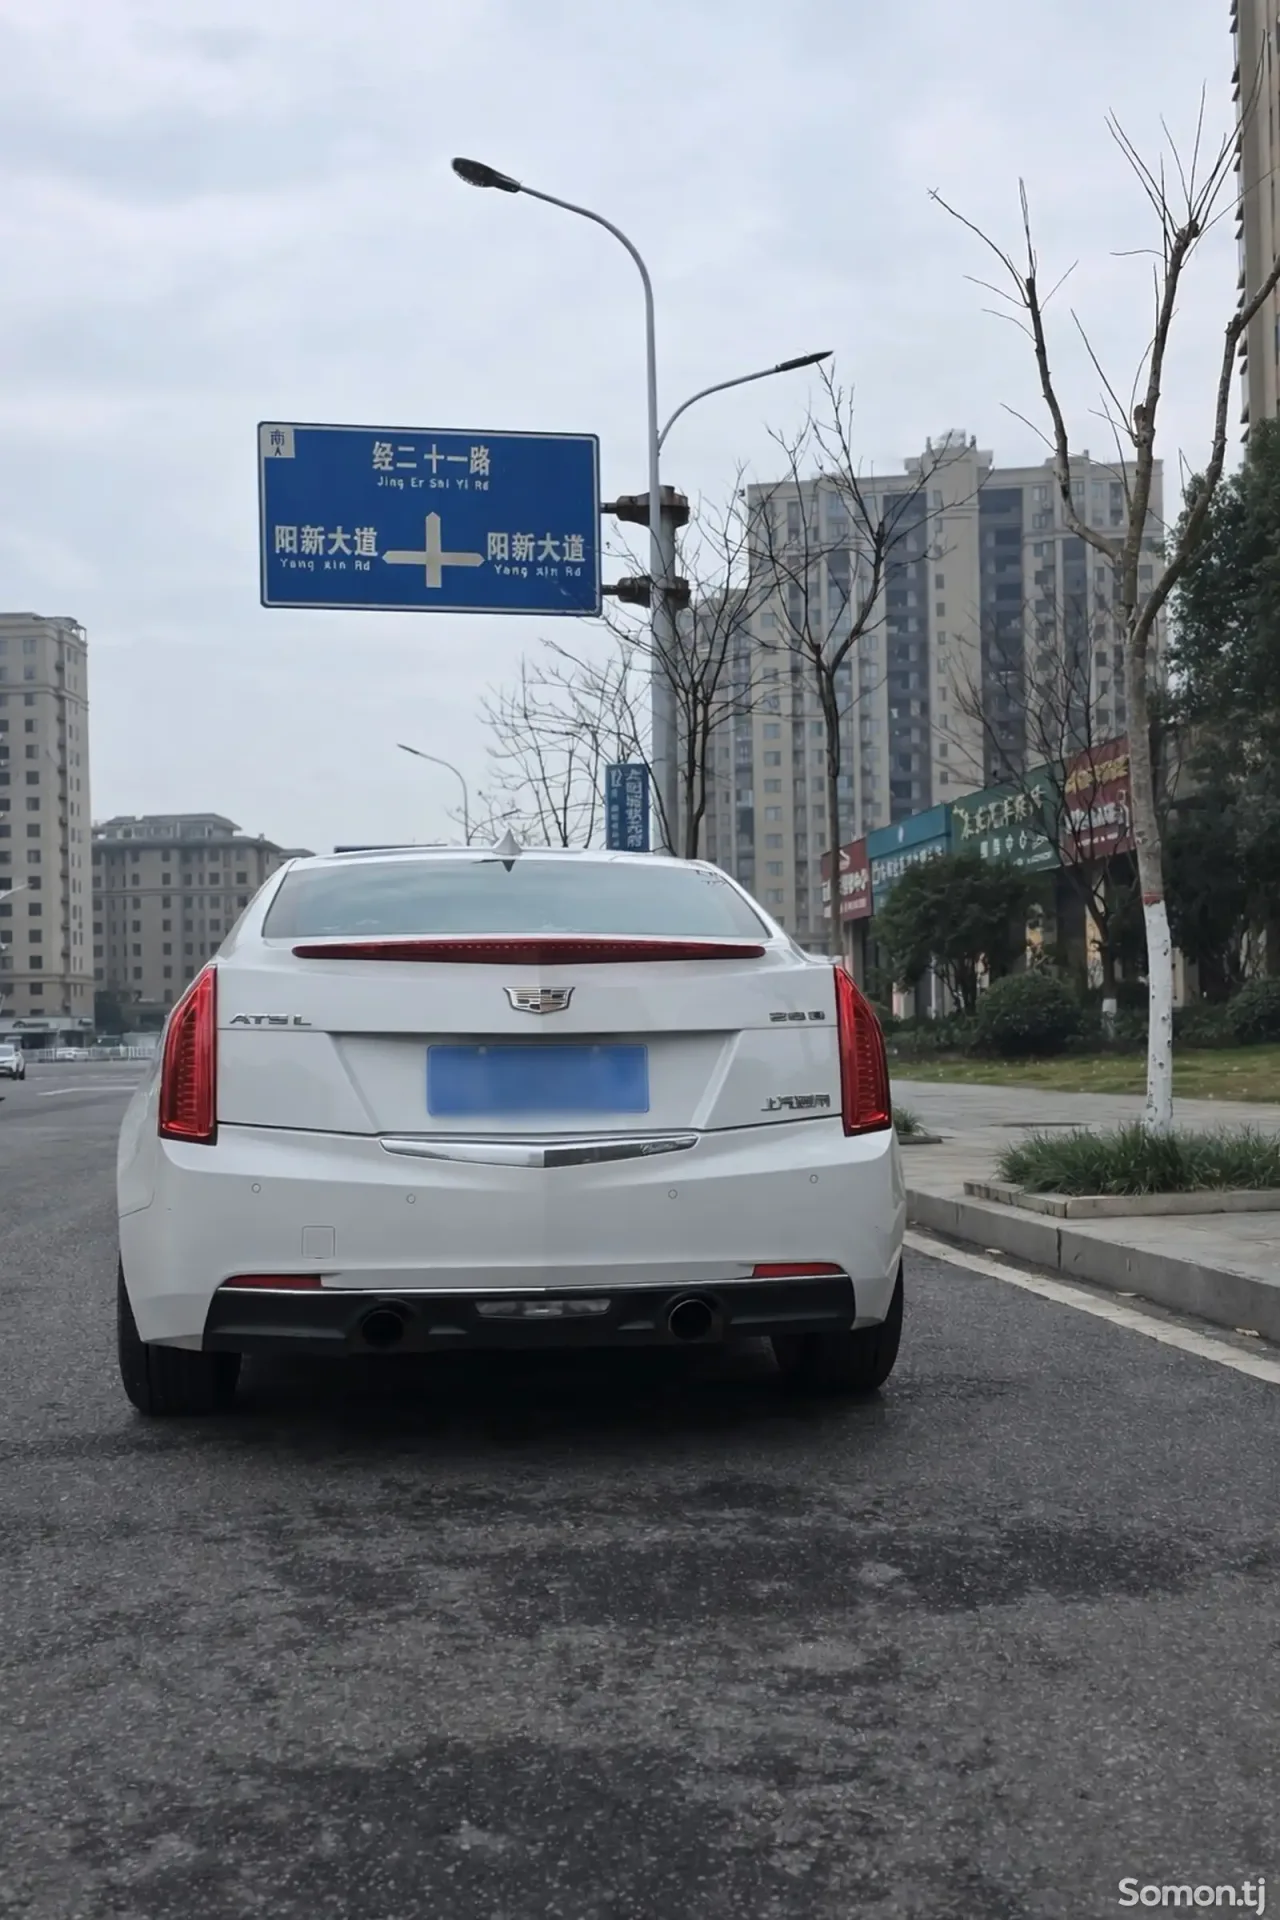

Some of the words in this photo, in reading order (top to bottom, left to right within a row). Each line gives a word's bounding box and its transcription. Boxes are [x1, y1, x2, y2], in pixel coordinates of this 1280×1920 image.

[269, 429, 285, 446] 南
[372, 441, 491, 476] 经二十一路
[377, 475, 404, 490] Jing
[410, 477, 425, 488] Er
[456, 479, 469, 490] Yi
[475, 480, 489, 491] Rd
[274, 524, 379, 557] 阳新大道
[487, 531, 586, 562] 阳新大道
[280, 558, 314, 572] Yang
[354, 560, 370, 571] Rd
[494, 563, 528, 578] Yang
[565, 566, 582, 577] Rd
